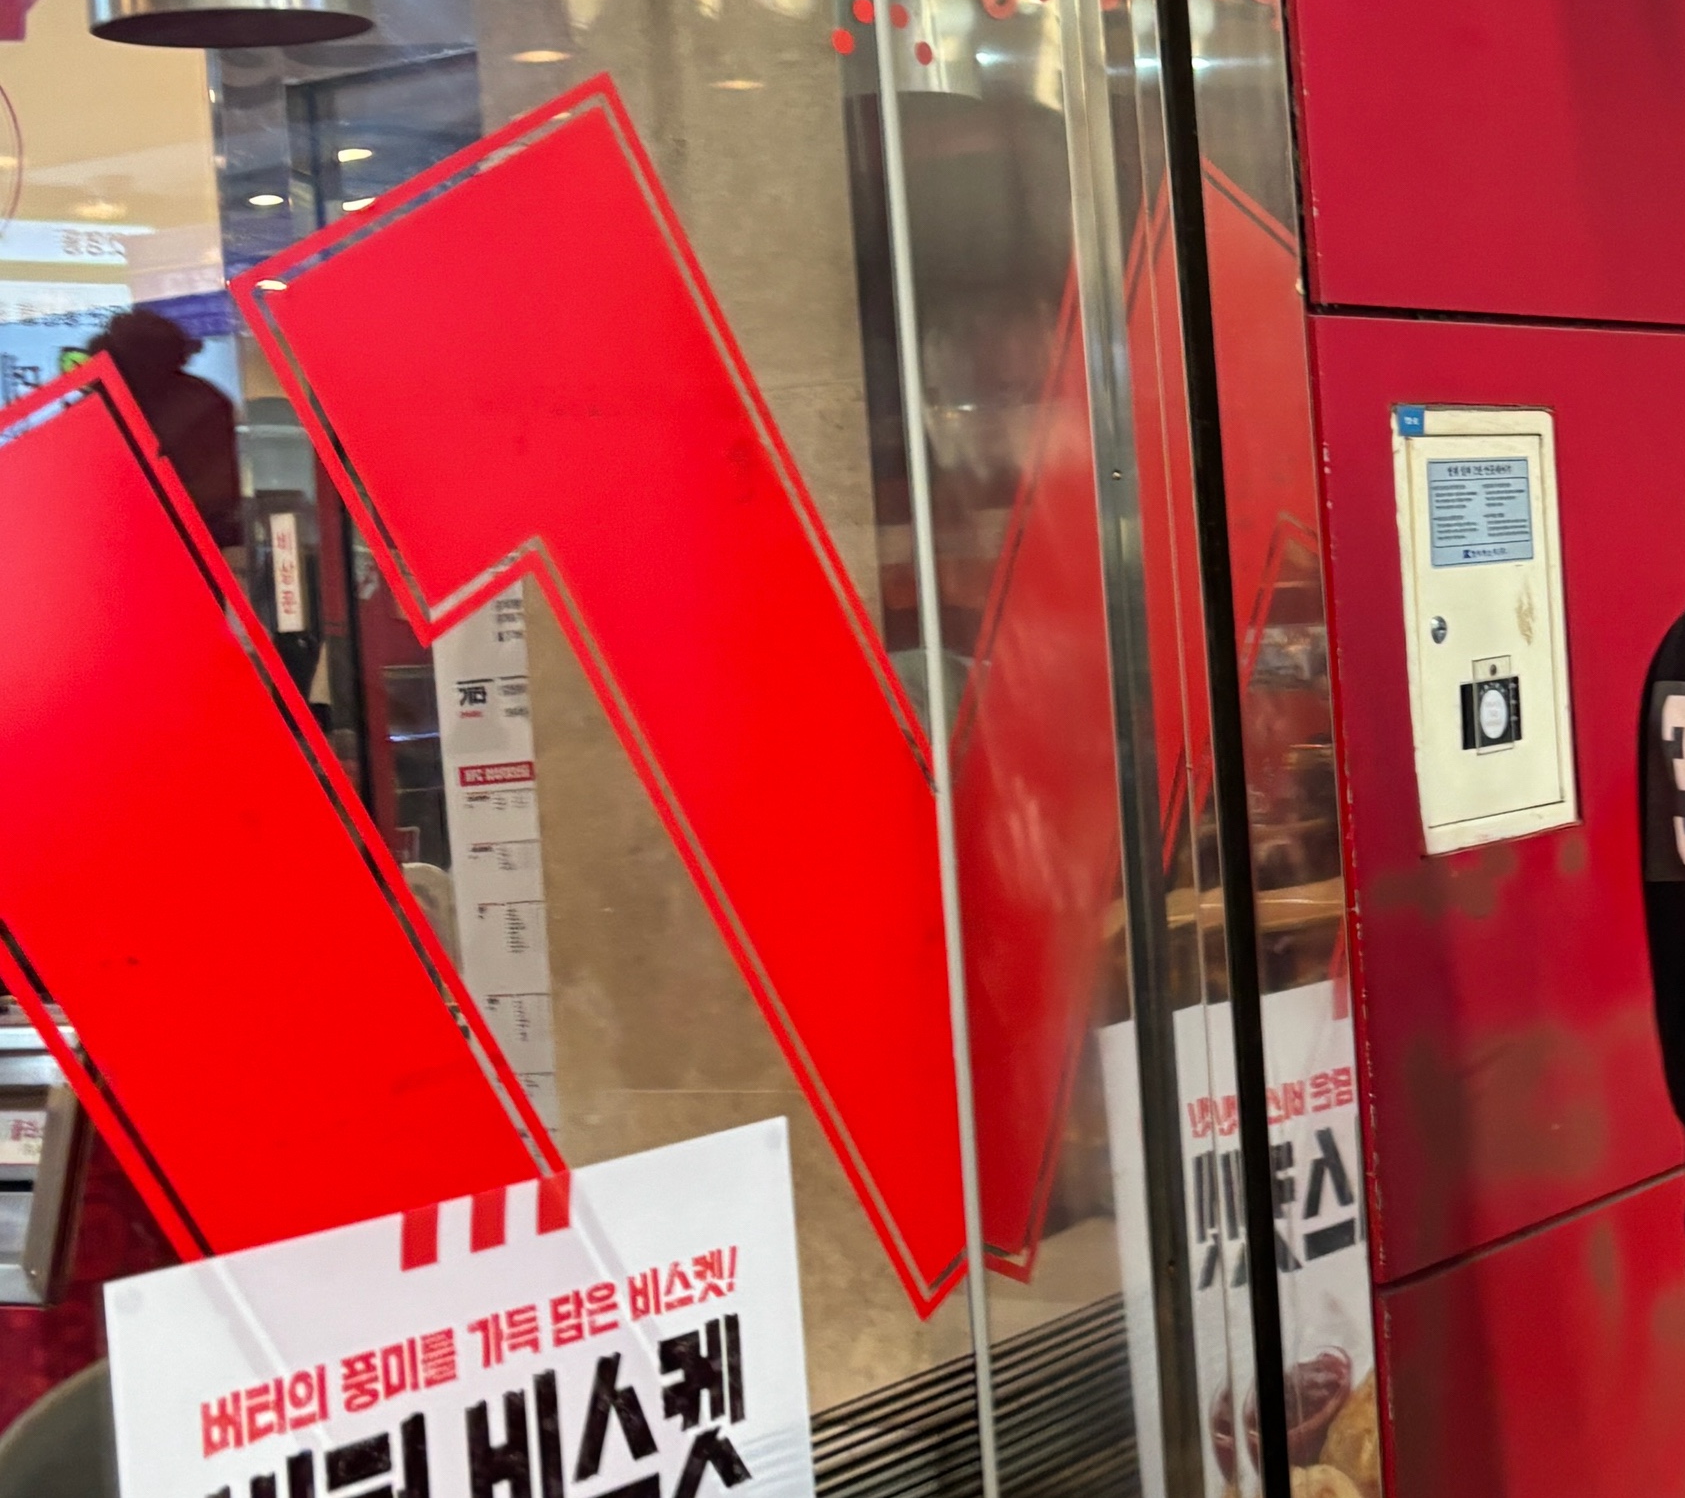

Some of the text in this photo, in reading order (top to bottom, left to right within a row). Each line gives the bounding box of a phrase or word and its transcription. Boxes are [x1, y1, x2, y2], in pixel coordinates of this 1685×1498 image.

[201, 1244, 739, 1459] 버터의 풍미를 가득 담은 비스켓!
